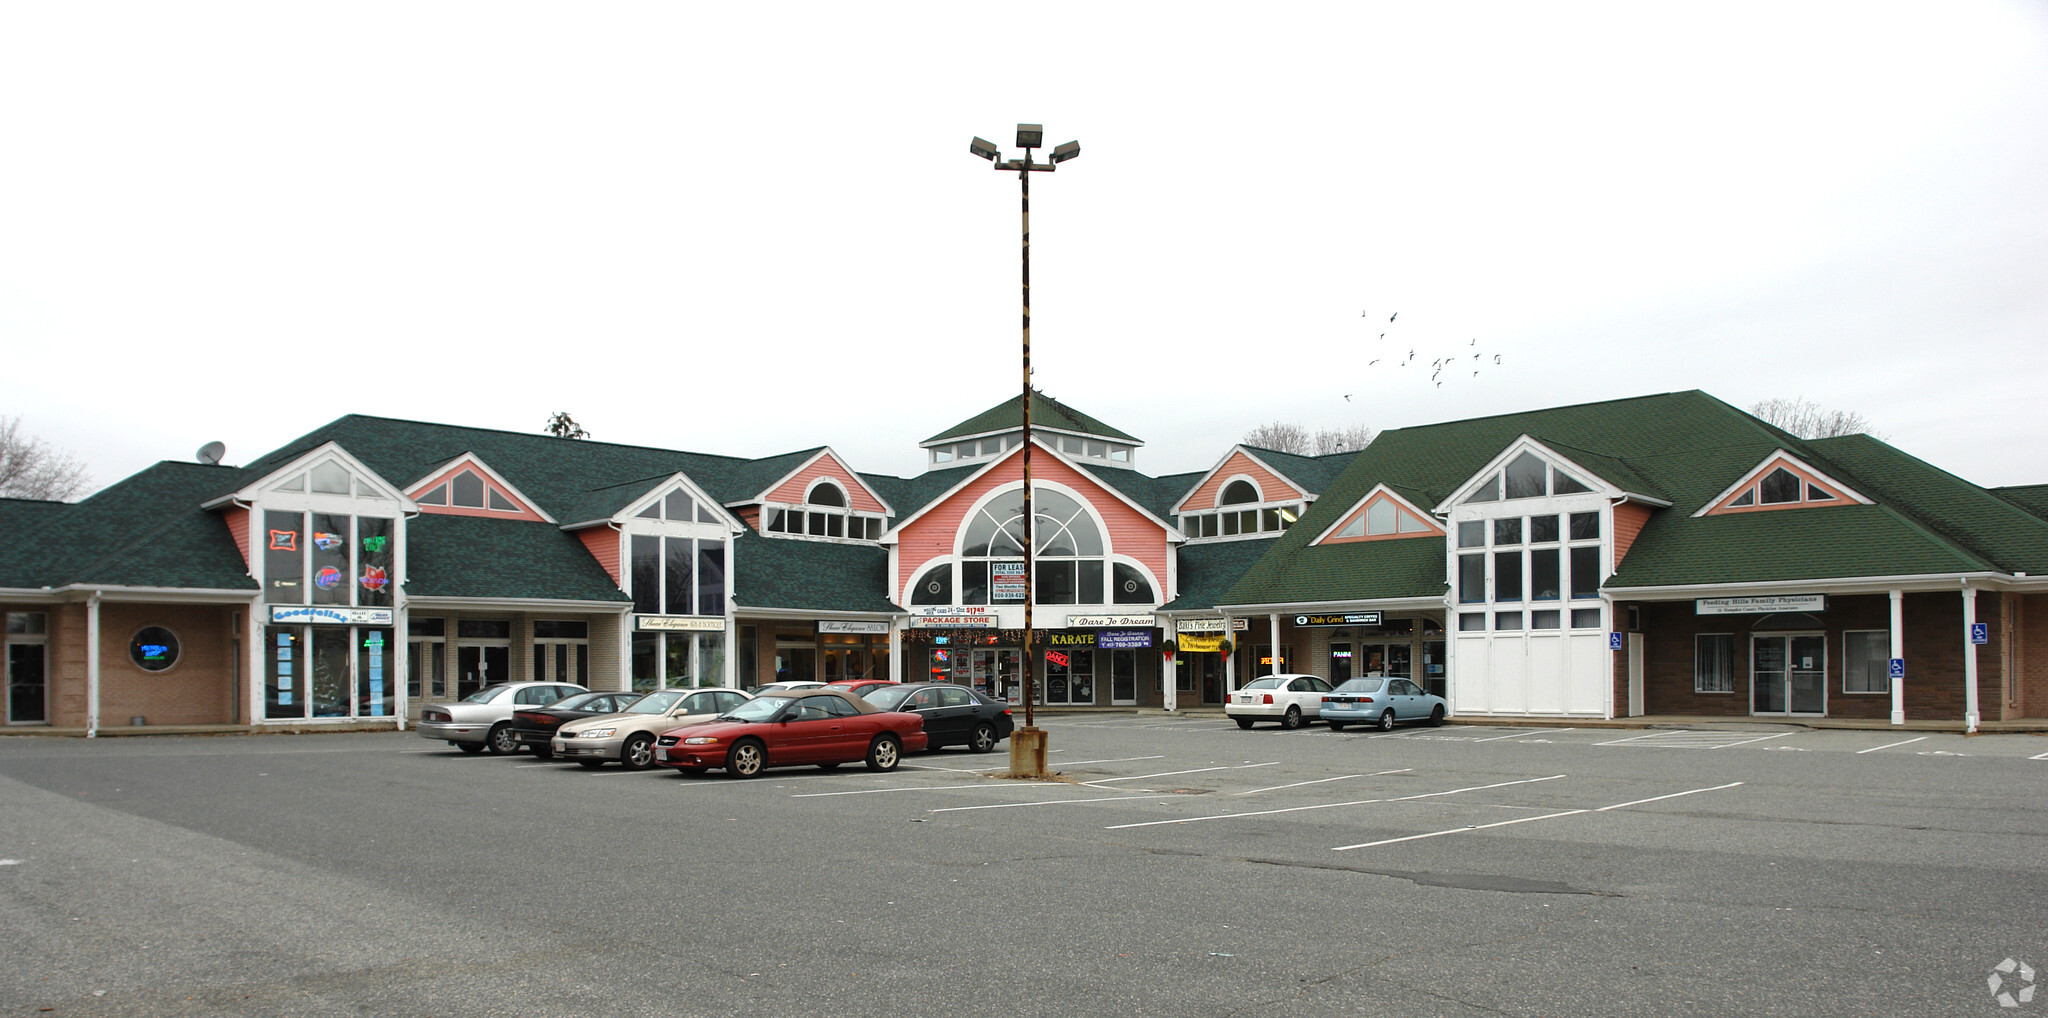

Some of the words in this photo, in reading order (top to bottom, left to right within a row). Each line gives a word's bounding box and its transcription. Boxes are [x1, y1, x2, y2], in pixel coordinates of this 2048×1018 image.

[1778, 596, 1817, 604] Physicians
[662, 618, 689, 629] Elegance
[1078, 617, 1104, 625] Dare
[1105, 617, 1117, 626] To
[1120, 616, 1154, 625] Dream
[1311, 616, 1325, 624] Daily
[1327, 615, 1344, 624] Grind
[841, 623, 866, 633] Elegance
[1051, 634, 1095, 645] KARATE
